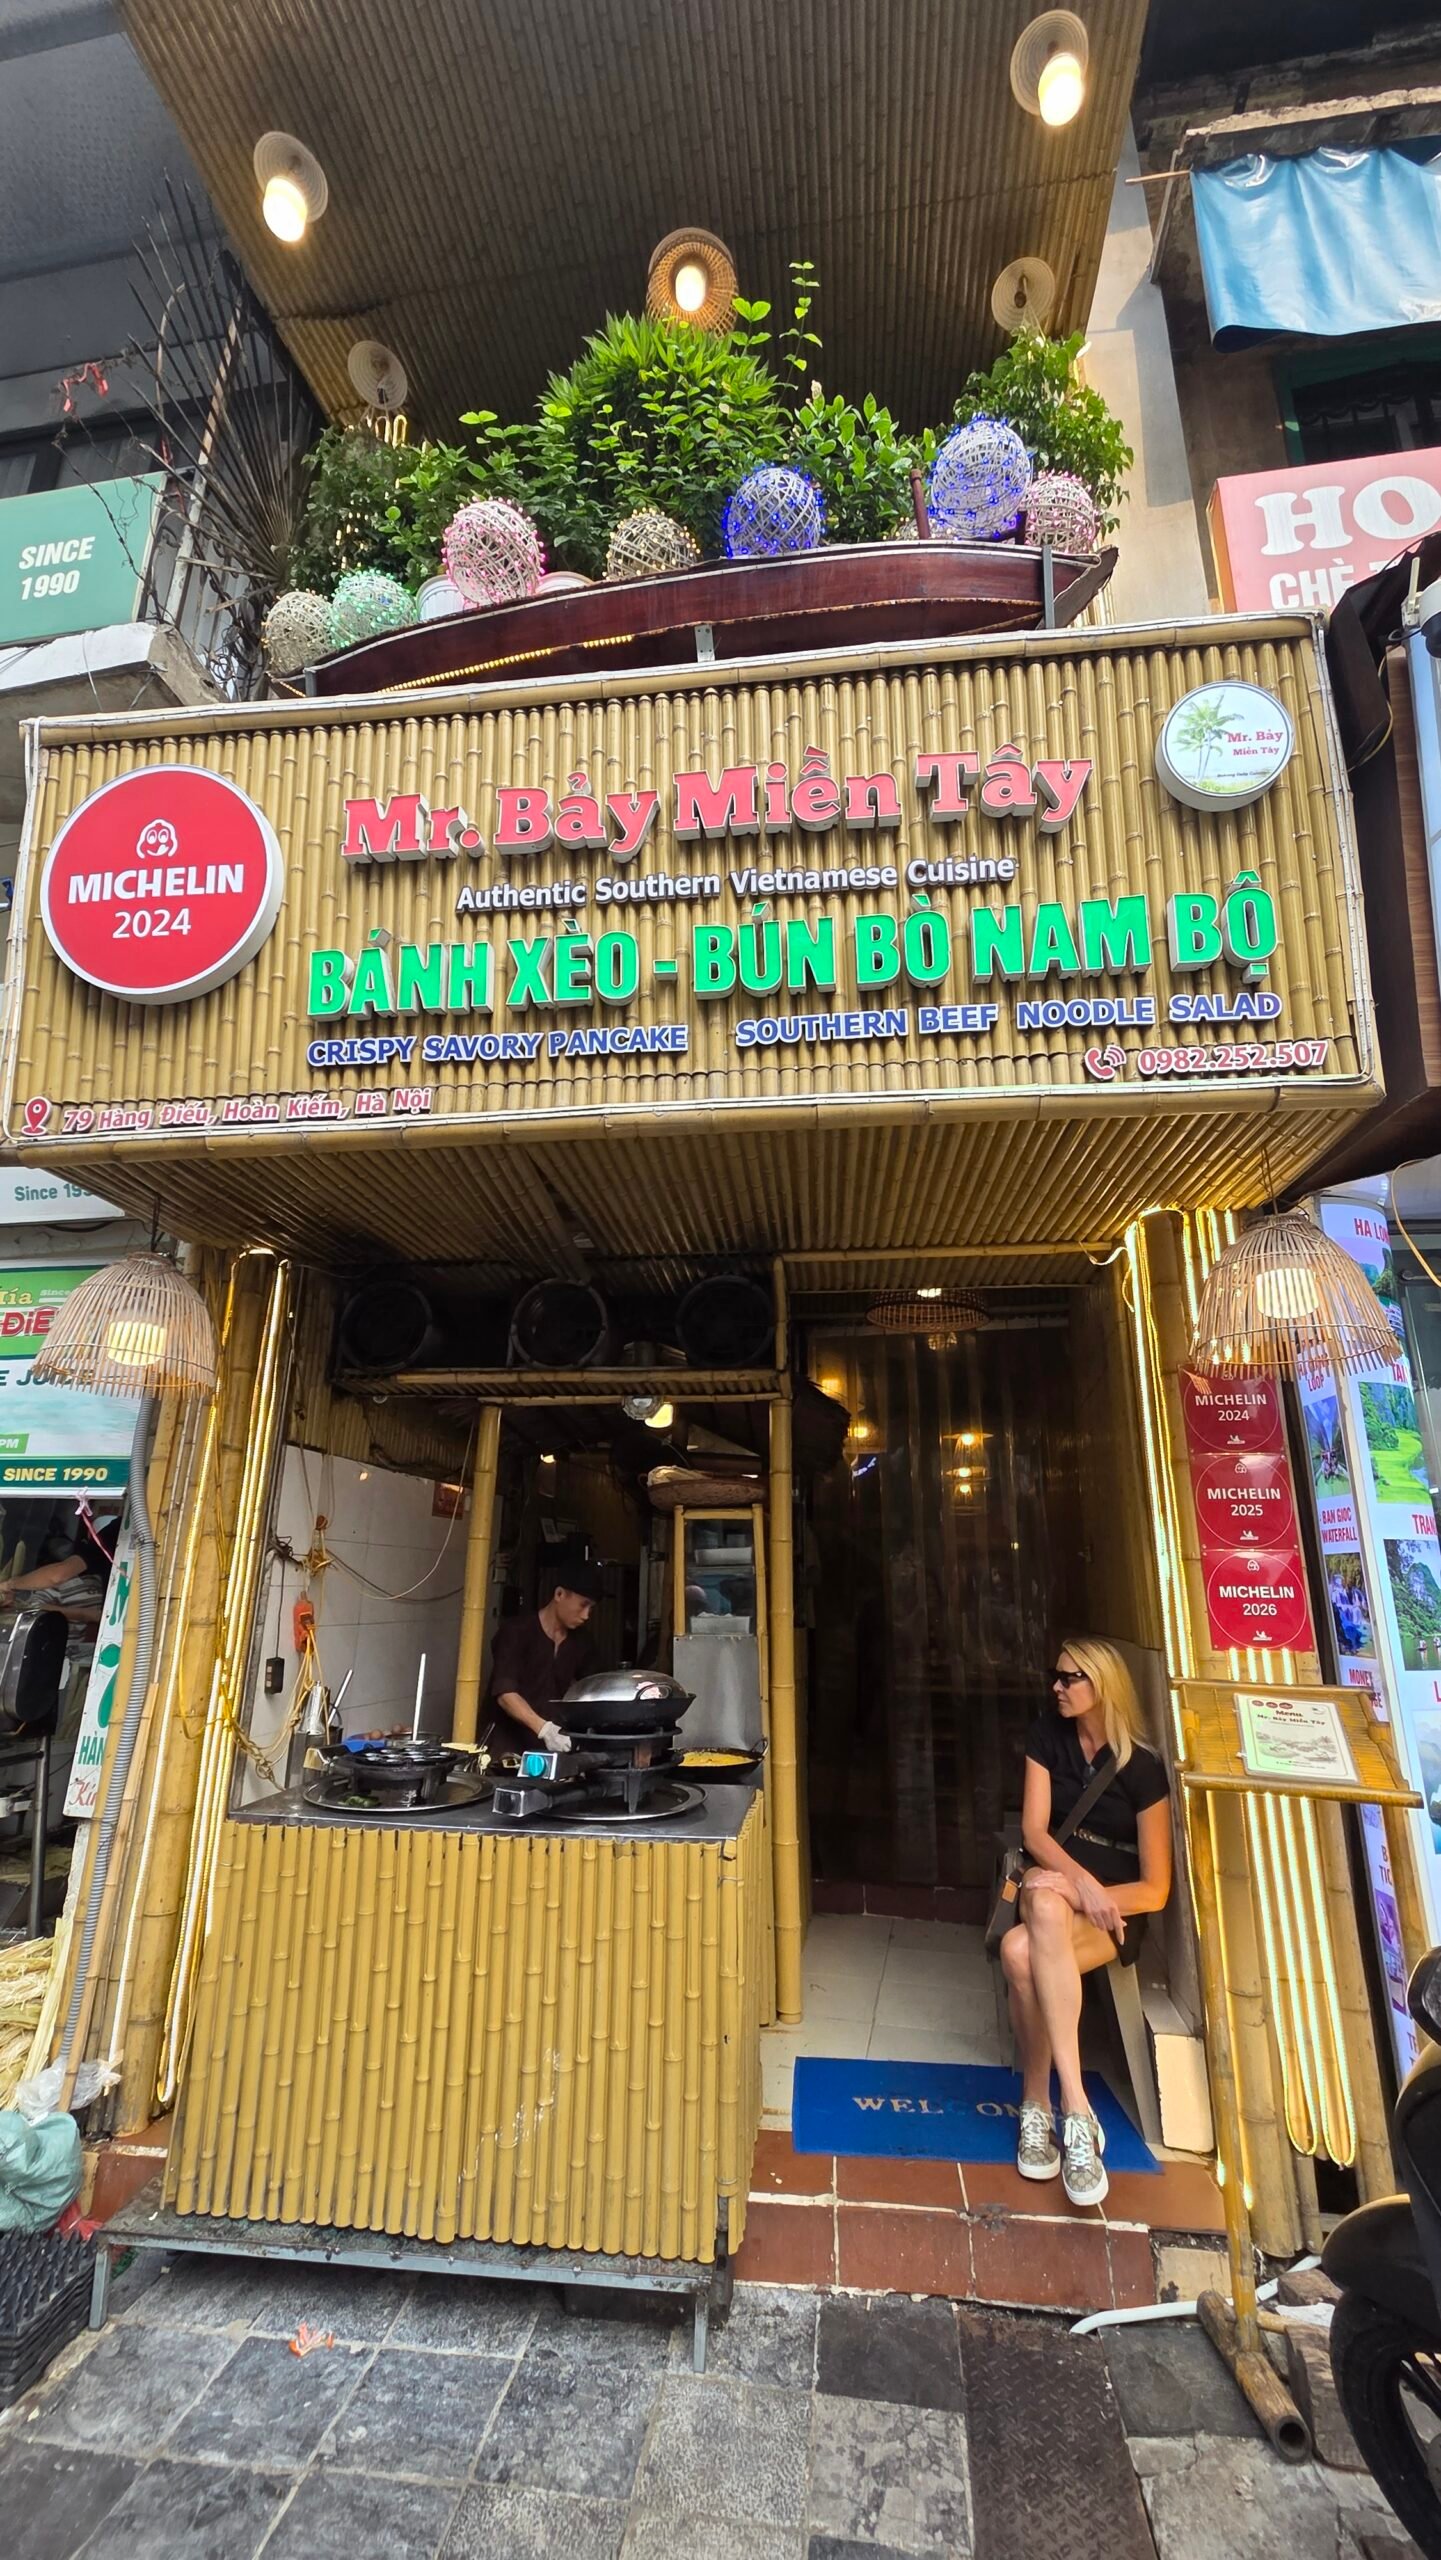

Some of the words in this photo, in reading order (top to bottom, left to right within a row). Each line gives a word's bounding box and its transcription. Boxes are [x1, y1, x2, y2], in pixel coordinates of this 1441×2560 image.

[19, 537, 95, 569] SINCE
[21, 570, 79, 600] 1990
[1269, 558, 1354, 610] CHÈ
[342, 793, 483, 858] Mr.
[494, 772, 660, 856] Bảy
[673, 745, 902, 833] Miền
[916, 742, 1093, 826] Tây
[68, 864, 244, 904] MICHELIN
[457, 881, 586, 910] Authentic
[595, 873, 720, 901] Southern
[731, 866, 897, 895] Vietnamese
[908, 857, 1015, 884] Cuisine
[112, 909, 191, 939] 2024
[308, 928, 491, 1016] BÁNH
[506, 919, 640, 1006] XÈO
[653, 960, 678, 976] -
[694, 902, 837, 993] BÚN
[855, 895, 951, 985] BÒ
[972, 894, 1152, 977] NAM
[1172, 870, 1277, 975] BỘ
[736, 1009, 908, 1047] SOUTHERN
[919, 1004, 998, 1034] BEEF
[1017, 997, 1155, 1030] NOODLE
[1169, 993, 1282, 1022] SALAD
[308, 1036, 416, 1066] CRISPY
[423, 1033, 543, 1061] SAVORY
[550, 1025, 688, 1057] PANCAKE
[1138, 1042, 1328, 1075] 0982.252.507
[63, 1109, 94, 1132] 79
[98, 1107, 151, 1130] Hàng
[222, 1099, 279, 1122] Hoàn
[355, 1091, 386, 1115] Hà
[393, 1087, 431, 1114] Nội
[14, 1185, 58, 1201] Since
[1354, 1218, 1373, 1237] HA
[1195, 1394, 1267, 1406] MICHELIN
[1217, 1410, 1250, 1421] 2024
[3, 1467, 58, 1481] SINCE
[63, 1467, 108, 1481] 1990
[1207, 1488, 1281, 1500] MICHELIN
[1231, 1504, 1264, 1516] 2025
[1321, 1527, 1358, 1543] WATERFALL
[1219, 1586, 1295, 1598] MICHELIN
[1243, 1603, 1278, 1616] 2026
